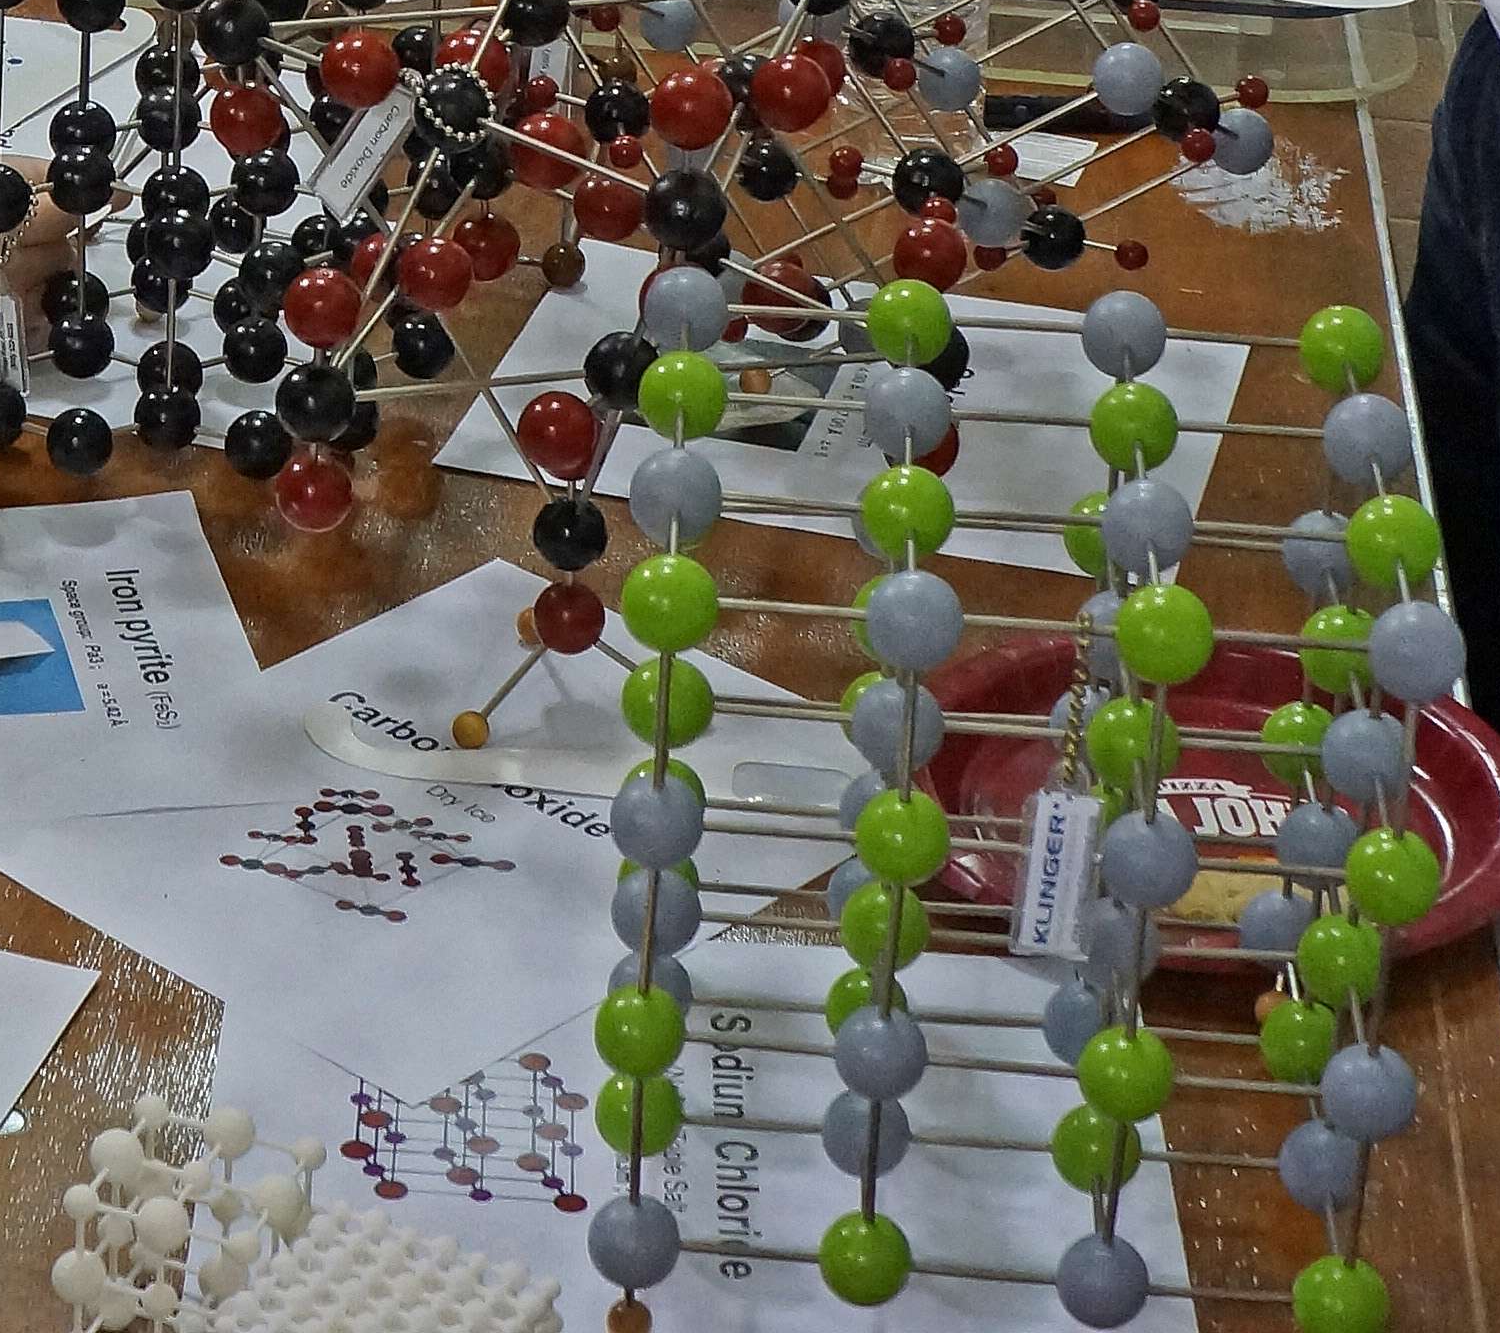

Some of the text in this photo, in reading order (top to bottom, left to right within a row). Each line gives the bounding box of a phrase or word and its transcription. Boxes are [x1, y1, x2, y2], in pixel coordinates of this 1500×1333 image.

[339, 104, 400, 189] Carbon Dioxide
[105, 568, 143, 614] Iron
[114, 617, 174, 684] pyrite
[426, 784, 497, 824] Dry Ice
[1033, 813, 1066, 945] KLINGER
